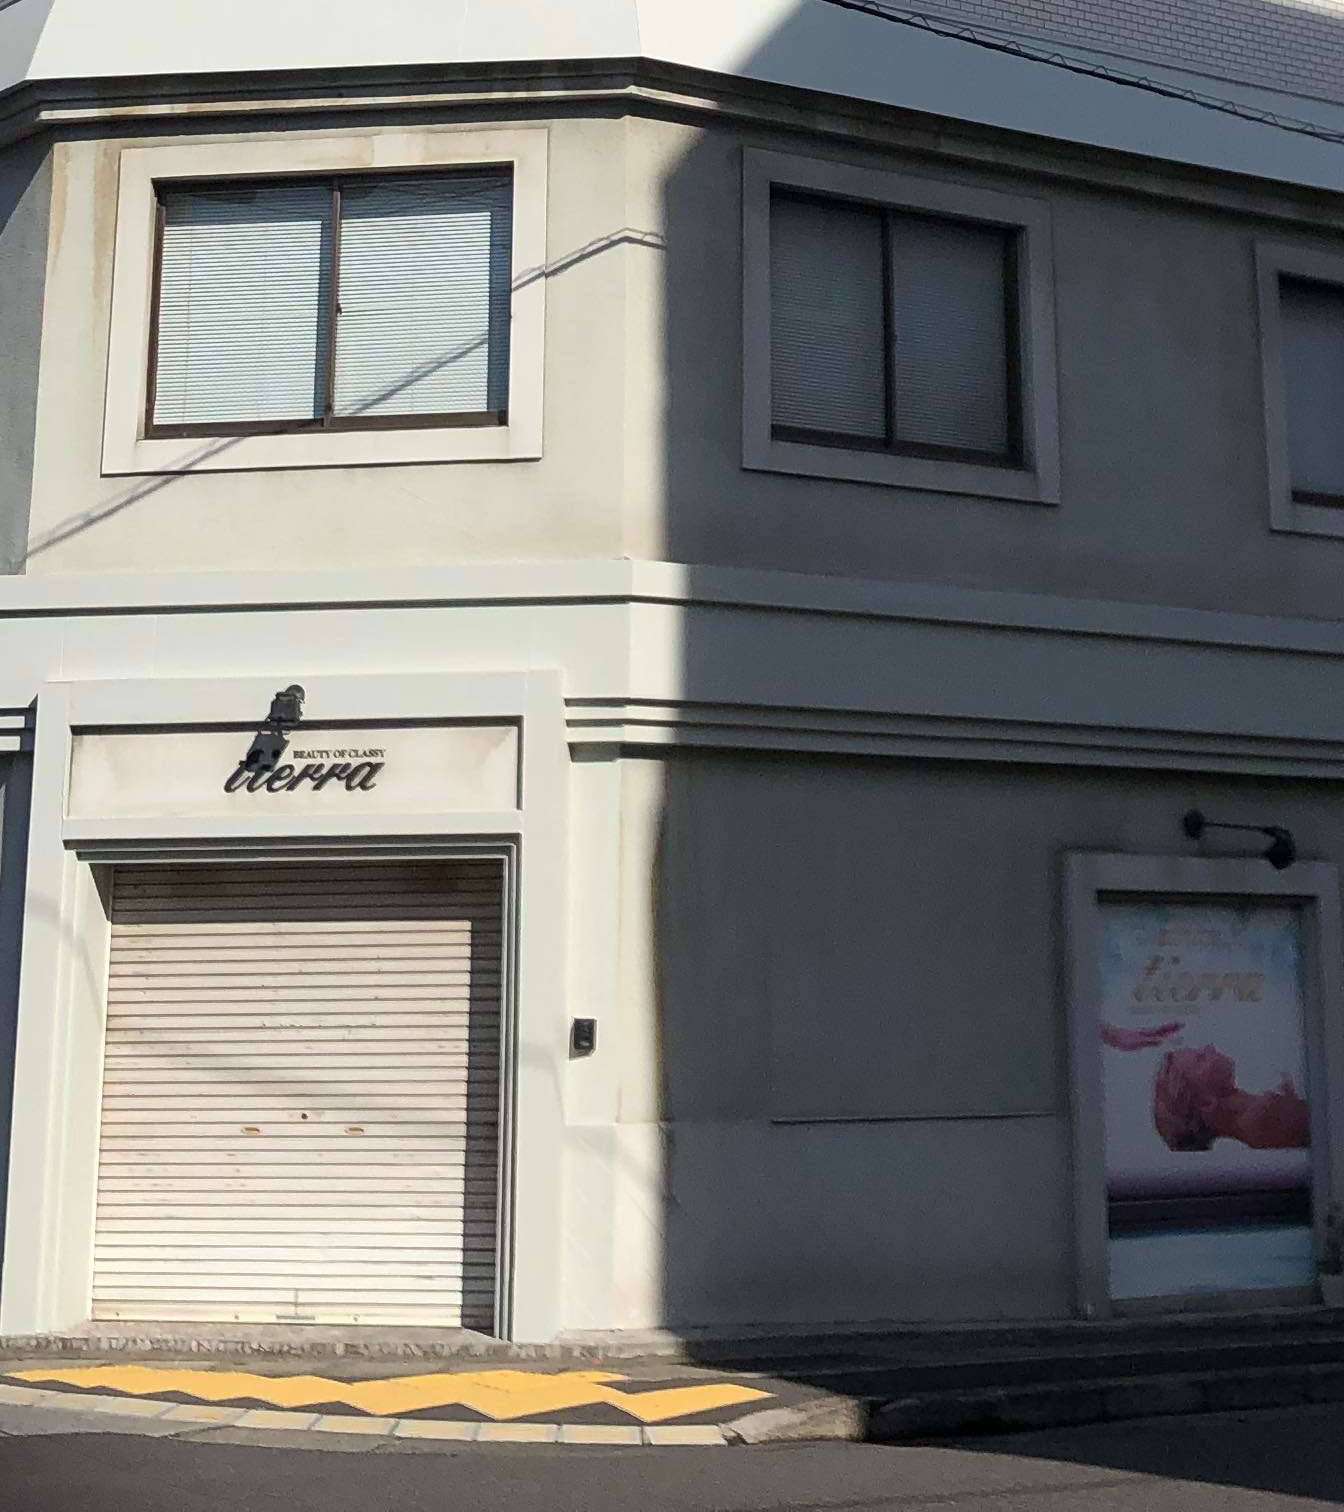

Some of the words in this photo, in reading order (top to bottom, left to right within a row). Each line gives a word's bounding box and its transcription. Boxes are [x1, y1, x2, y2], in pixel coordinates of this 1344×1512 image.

[292, 749, 331, 759] BEAUTY
[333, 749, 348, 759] OF
[348, 748, 387, 758] CLASSY
